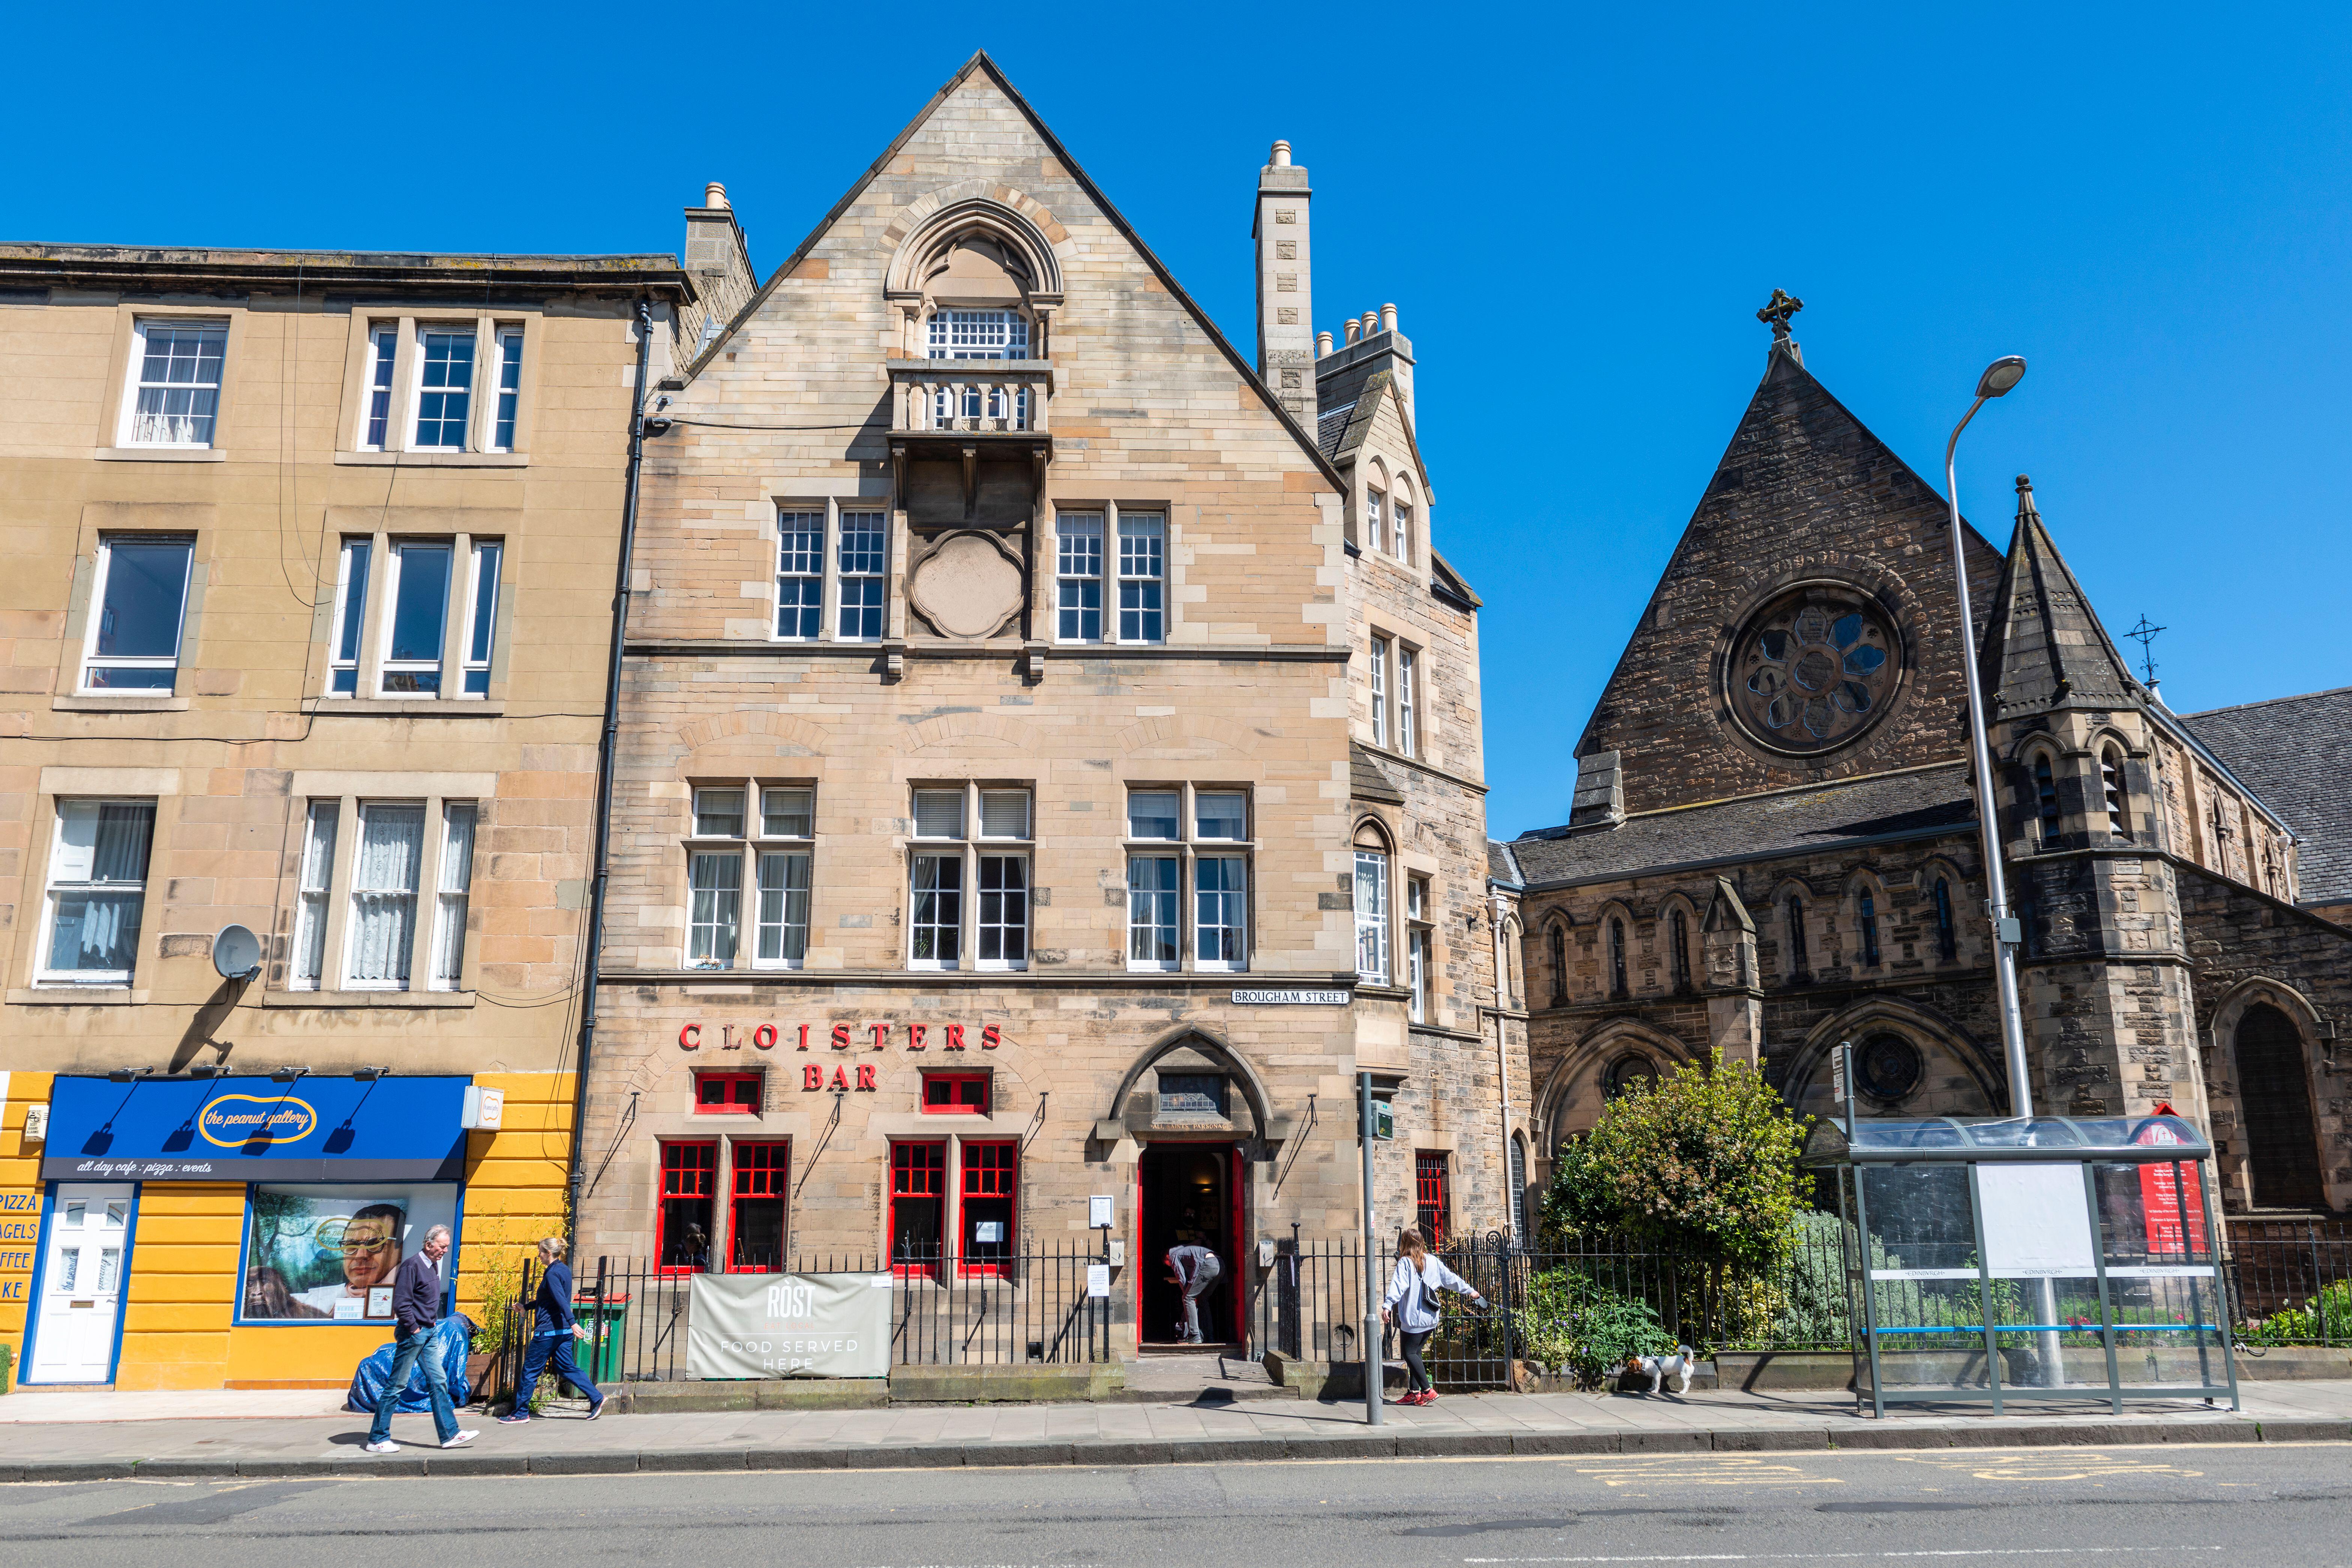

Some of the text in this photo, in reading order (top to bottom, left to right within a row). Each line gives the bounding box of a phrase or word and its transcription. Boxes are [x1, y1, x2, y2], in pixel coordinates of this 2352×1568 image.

[1235, 992, 1346, 1002] BROUGHAM STREET
[680, 1023, 1001, 1048] CLOISTERS
[803, 1064, 878, 1089] BAR
[206, 1110, 309, 1130] the peanut gallery
[77, 1160, 94, 1171] all
[93, 1161, 114, 1176] day
[115, 1160, 137, 1175] cafe
[143, 1162, 174, 1176] pizza
[182, 1162, 212, 1173] events
[767, 1279, 816, 1318] RÒST
[721, 1340, 858, 1353] FOOD SERVED
[764, 1358, 813, 1370] HERE
